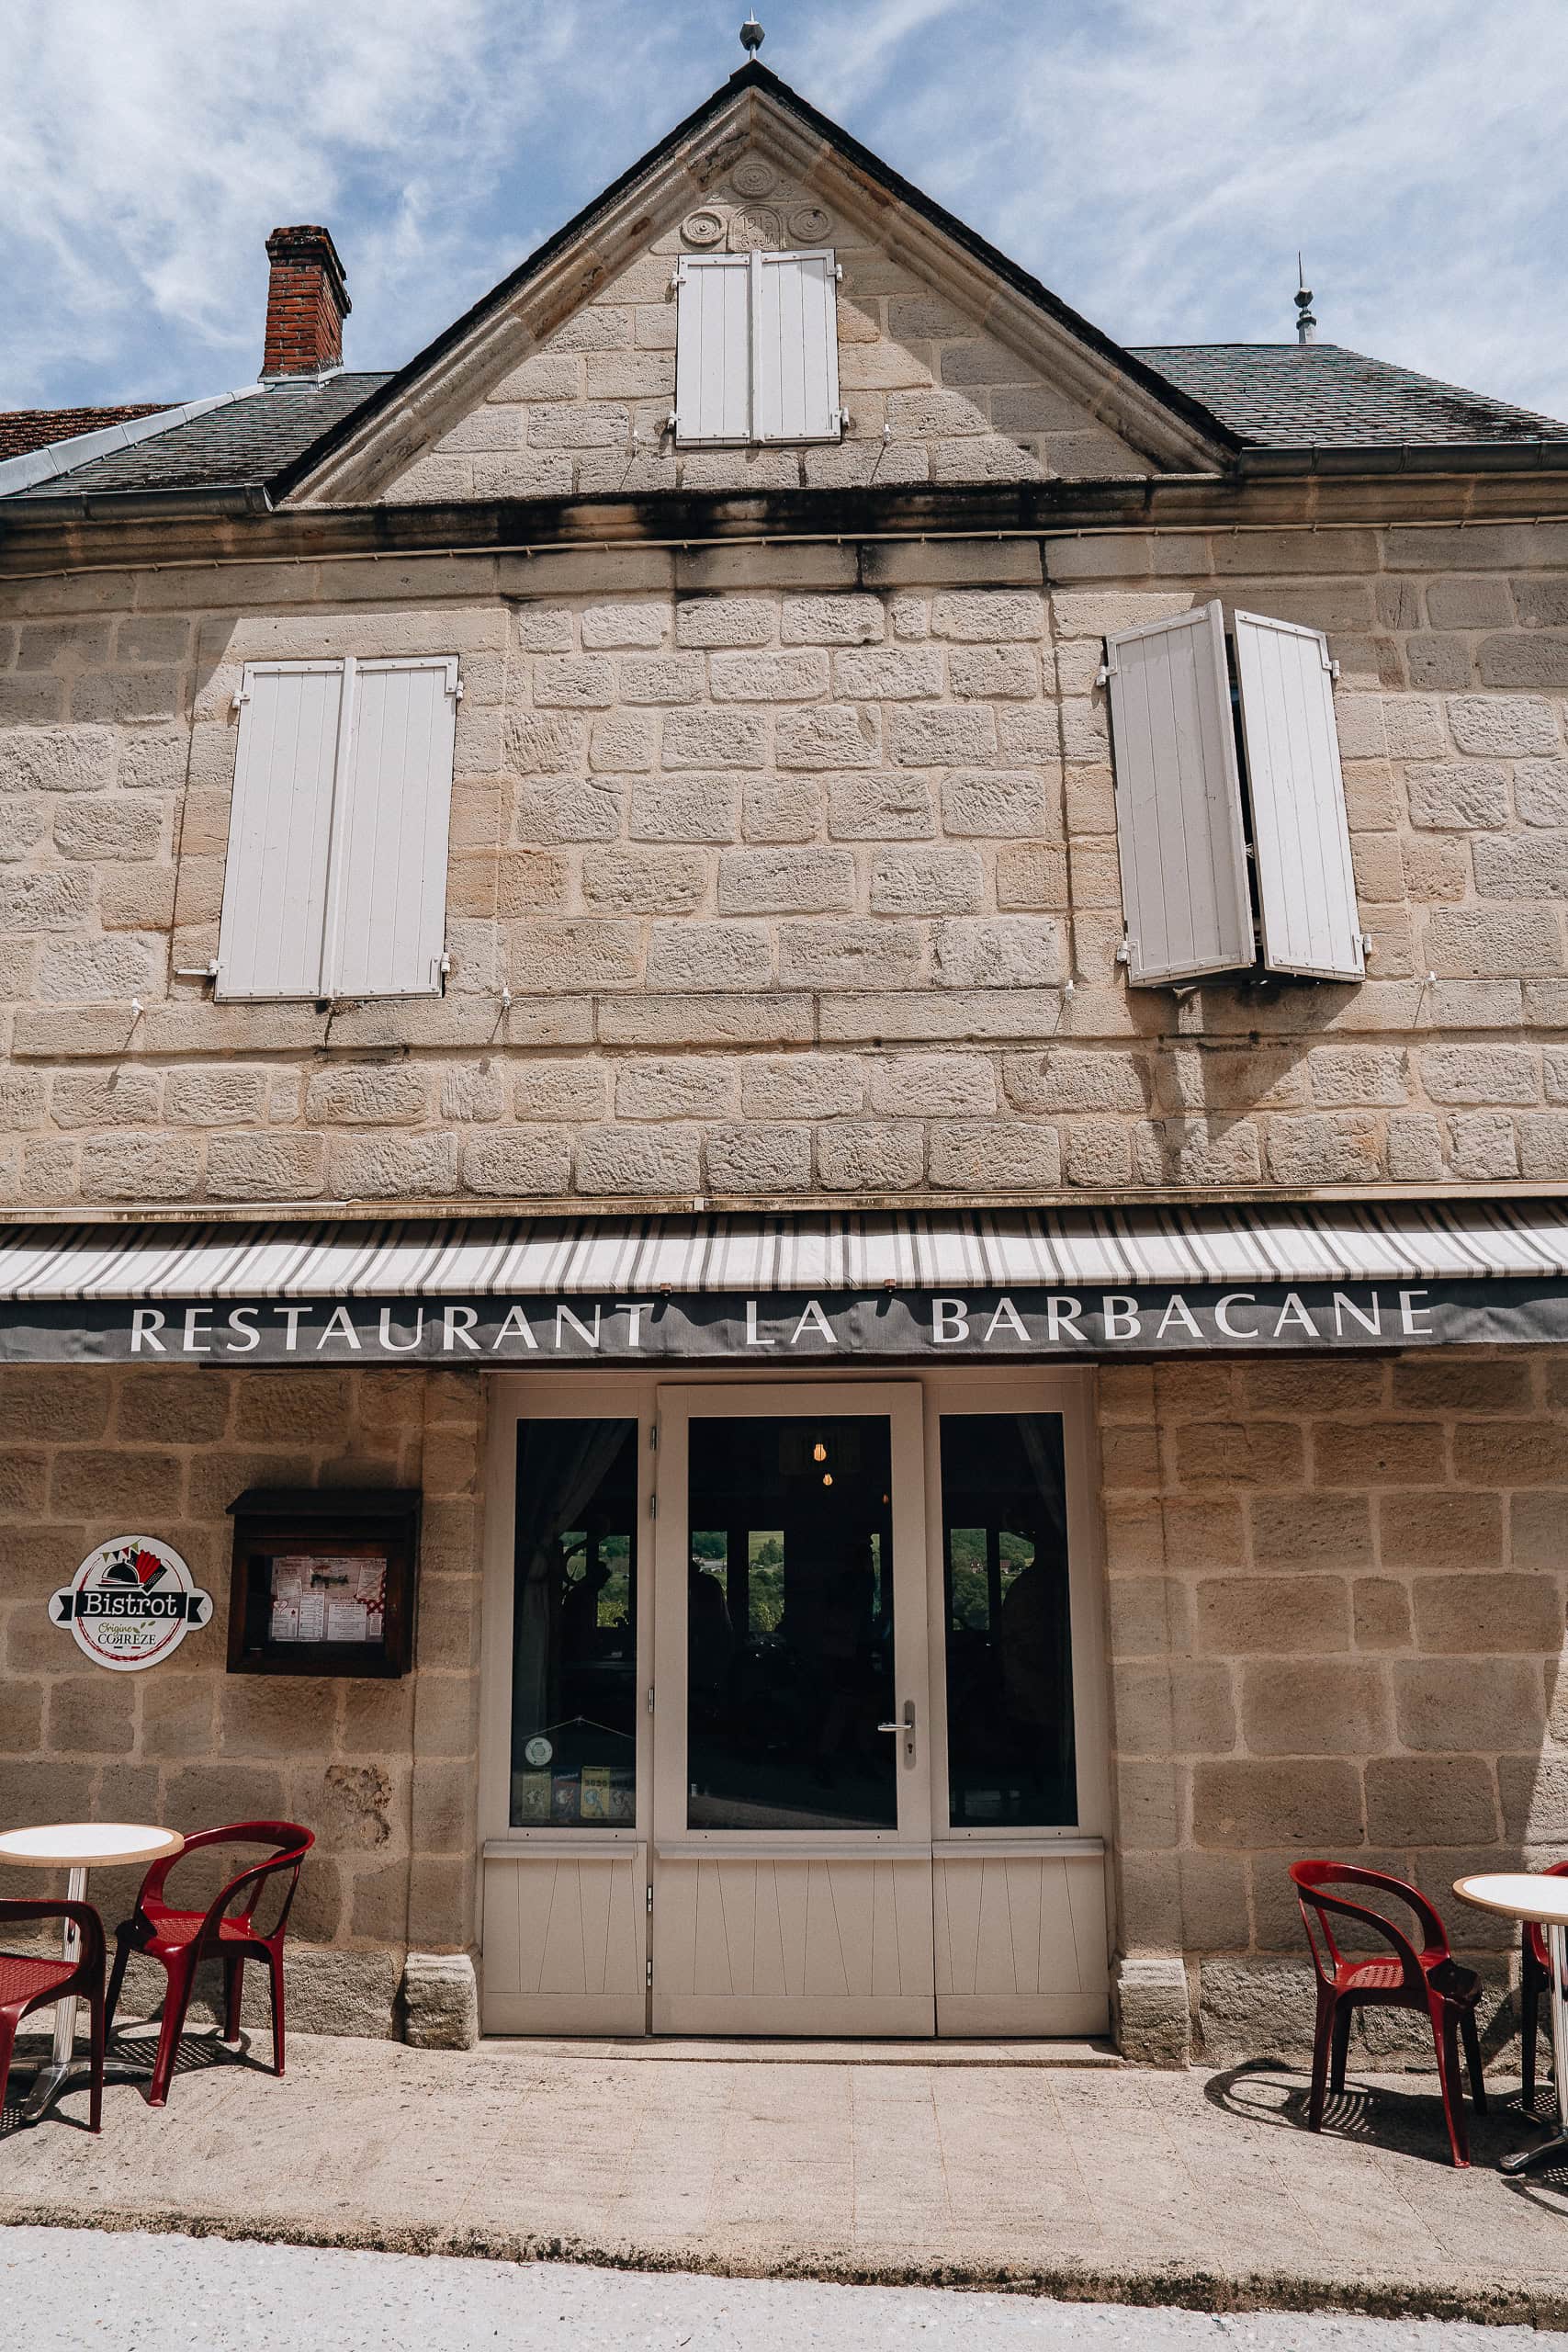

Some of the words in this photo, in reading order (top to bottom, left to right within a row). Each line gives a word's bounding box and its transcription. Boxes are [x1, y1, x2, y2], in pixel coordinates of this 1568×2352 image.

[130, 1303, 655, 1352] RESTAURANT
[745, 1300, 839, 1345] LA
[932, 1290, 1433, 1343] BARBACANE
[83, 1592, 177, 1616] Bistrot
[98, 1622, 133, 1636] Origine
